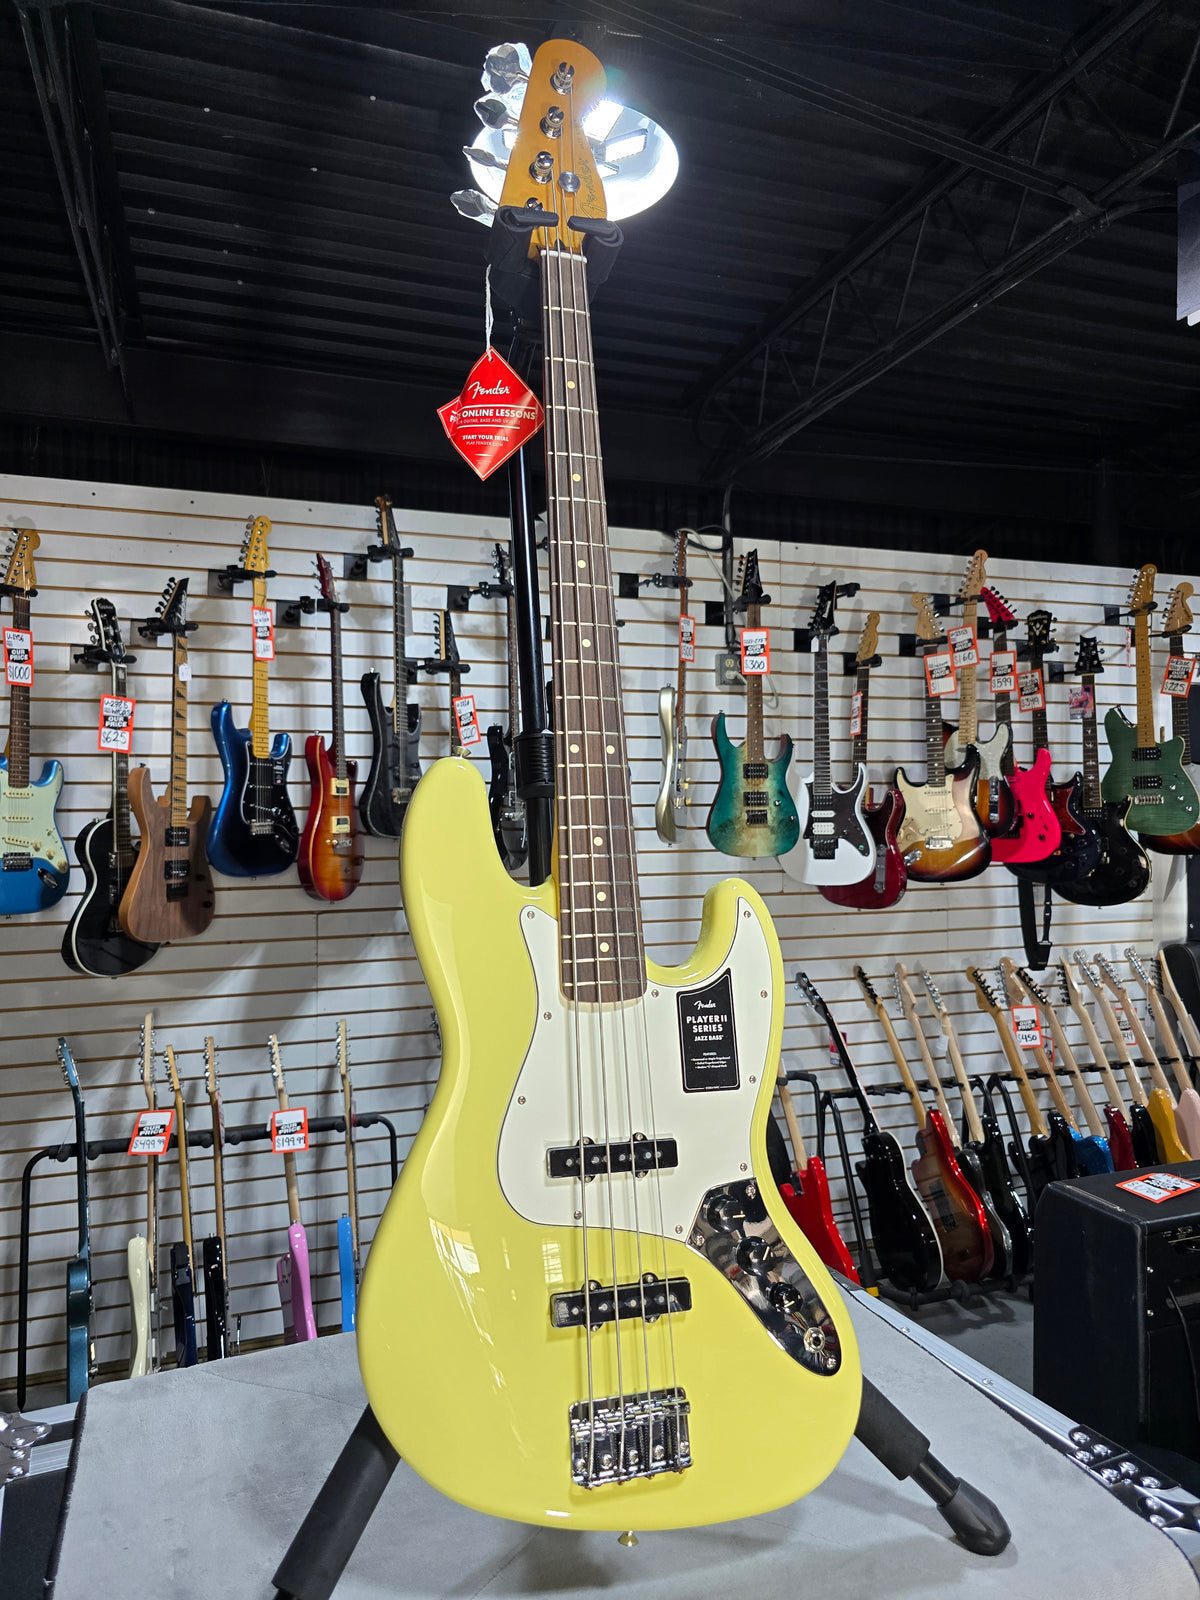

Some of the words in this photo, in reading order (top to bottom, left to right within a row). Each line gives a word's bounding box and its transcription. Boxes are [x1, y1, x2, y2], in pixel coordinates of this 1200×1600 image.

[468, 380, 510, 399] Fender
[462, 409, 494, 418] ONLINE
[496, 409, 536, 420] LESSONS
[992, 677, 1012, 688] $599
[1165, 682, 1185, 691] $225
[102, 731, 127, 744] $625
[694, 1000, 716, 1010] Fender
[686, 1015, 719, 1024] PLAYER
[692, 1024, 723, 1033] SERIES
[139, 1128, 164, 1136] PRICE
[278, 1126, 301, 1134] PRICE
